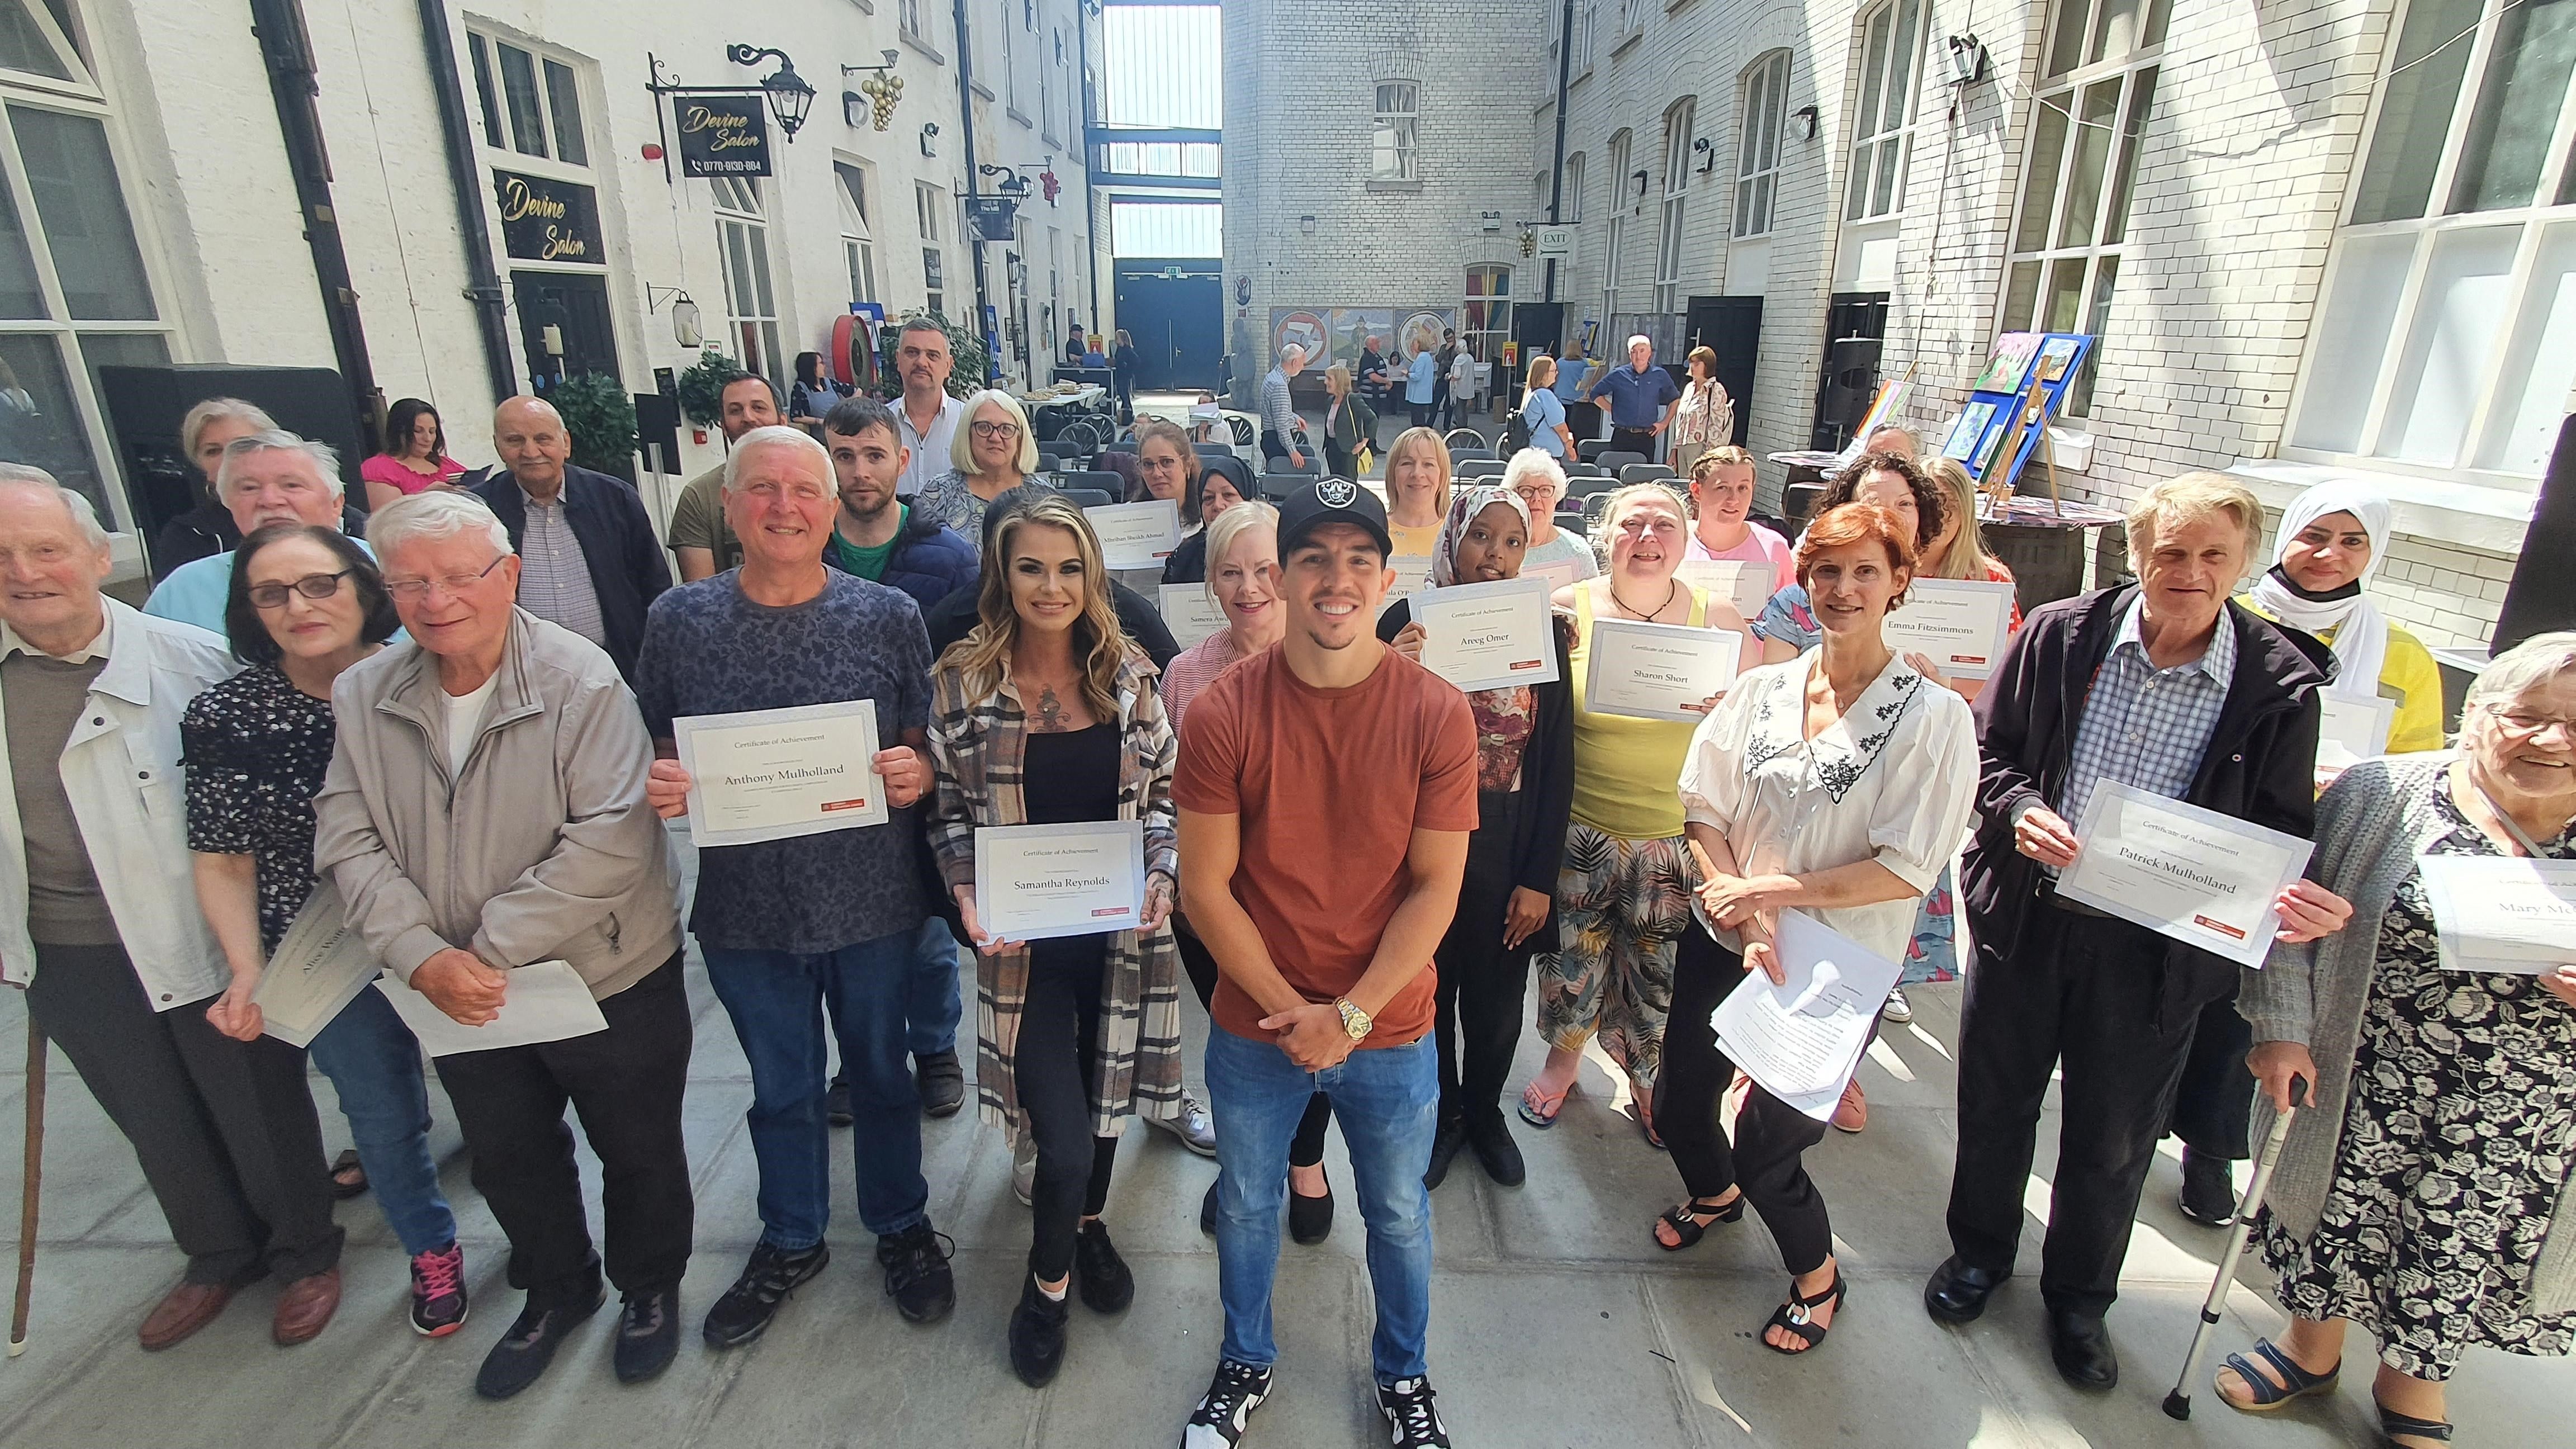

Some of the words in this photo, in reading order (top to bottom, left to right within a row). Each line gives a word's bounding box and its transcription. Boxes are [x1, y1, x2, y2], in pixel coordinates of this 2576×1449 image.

[683, 105, 749, 133] Devine
[710, 128, 760, 151] Salon
[503, 174, 566, 221] Devine
[542, 224, 586, 260] Salon
[1544, 234, 1567, 243] EXIT
[1888, 621, 1915, 630] Emma
[1917, 623, 1974, 634] Fitzsimmons
[1486, 633, 1509, 642] Omer
[1633, 670, 1663, 680] Sharon
[1665, 673, 1688, 684] Short
[734, 739, 770, 749] Certificate
[780, 734, 825, 745] Achievement
[725, 772, 774, 786] Anthony
[778, 764, 844, 781] Mulholland
[2142, 820, 2180, 837] Certificate
[2119, 846, 2160, 869] Patrick
[2163, 861, 2237, 894] Mulholland
[1014, 878, 1062, 890] Samantha
[1065, 876, 1110, 889] Reynolds
[2499, 903, 2541, 916] Mary
